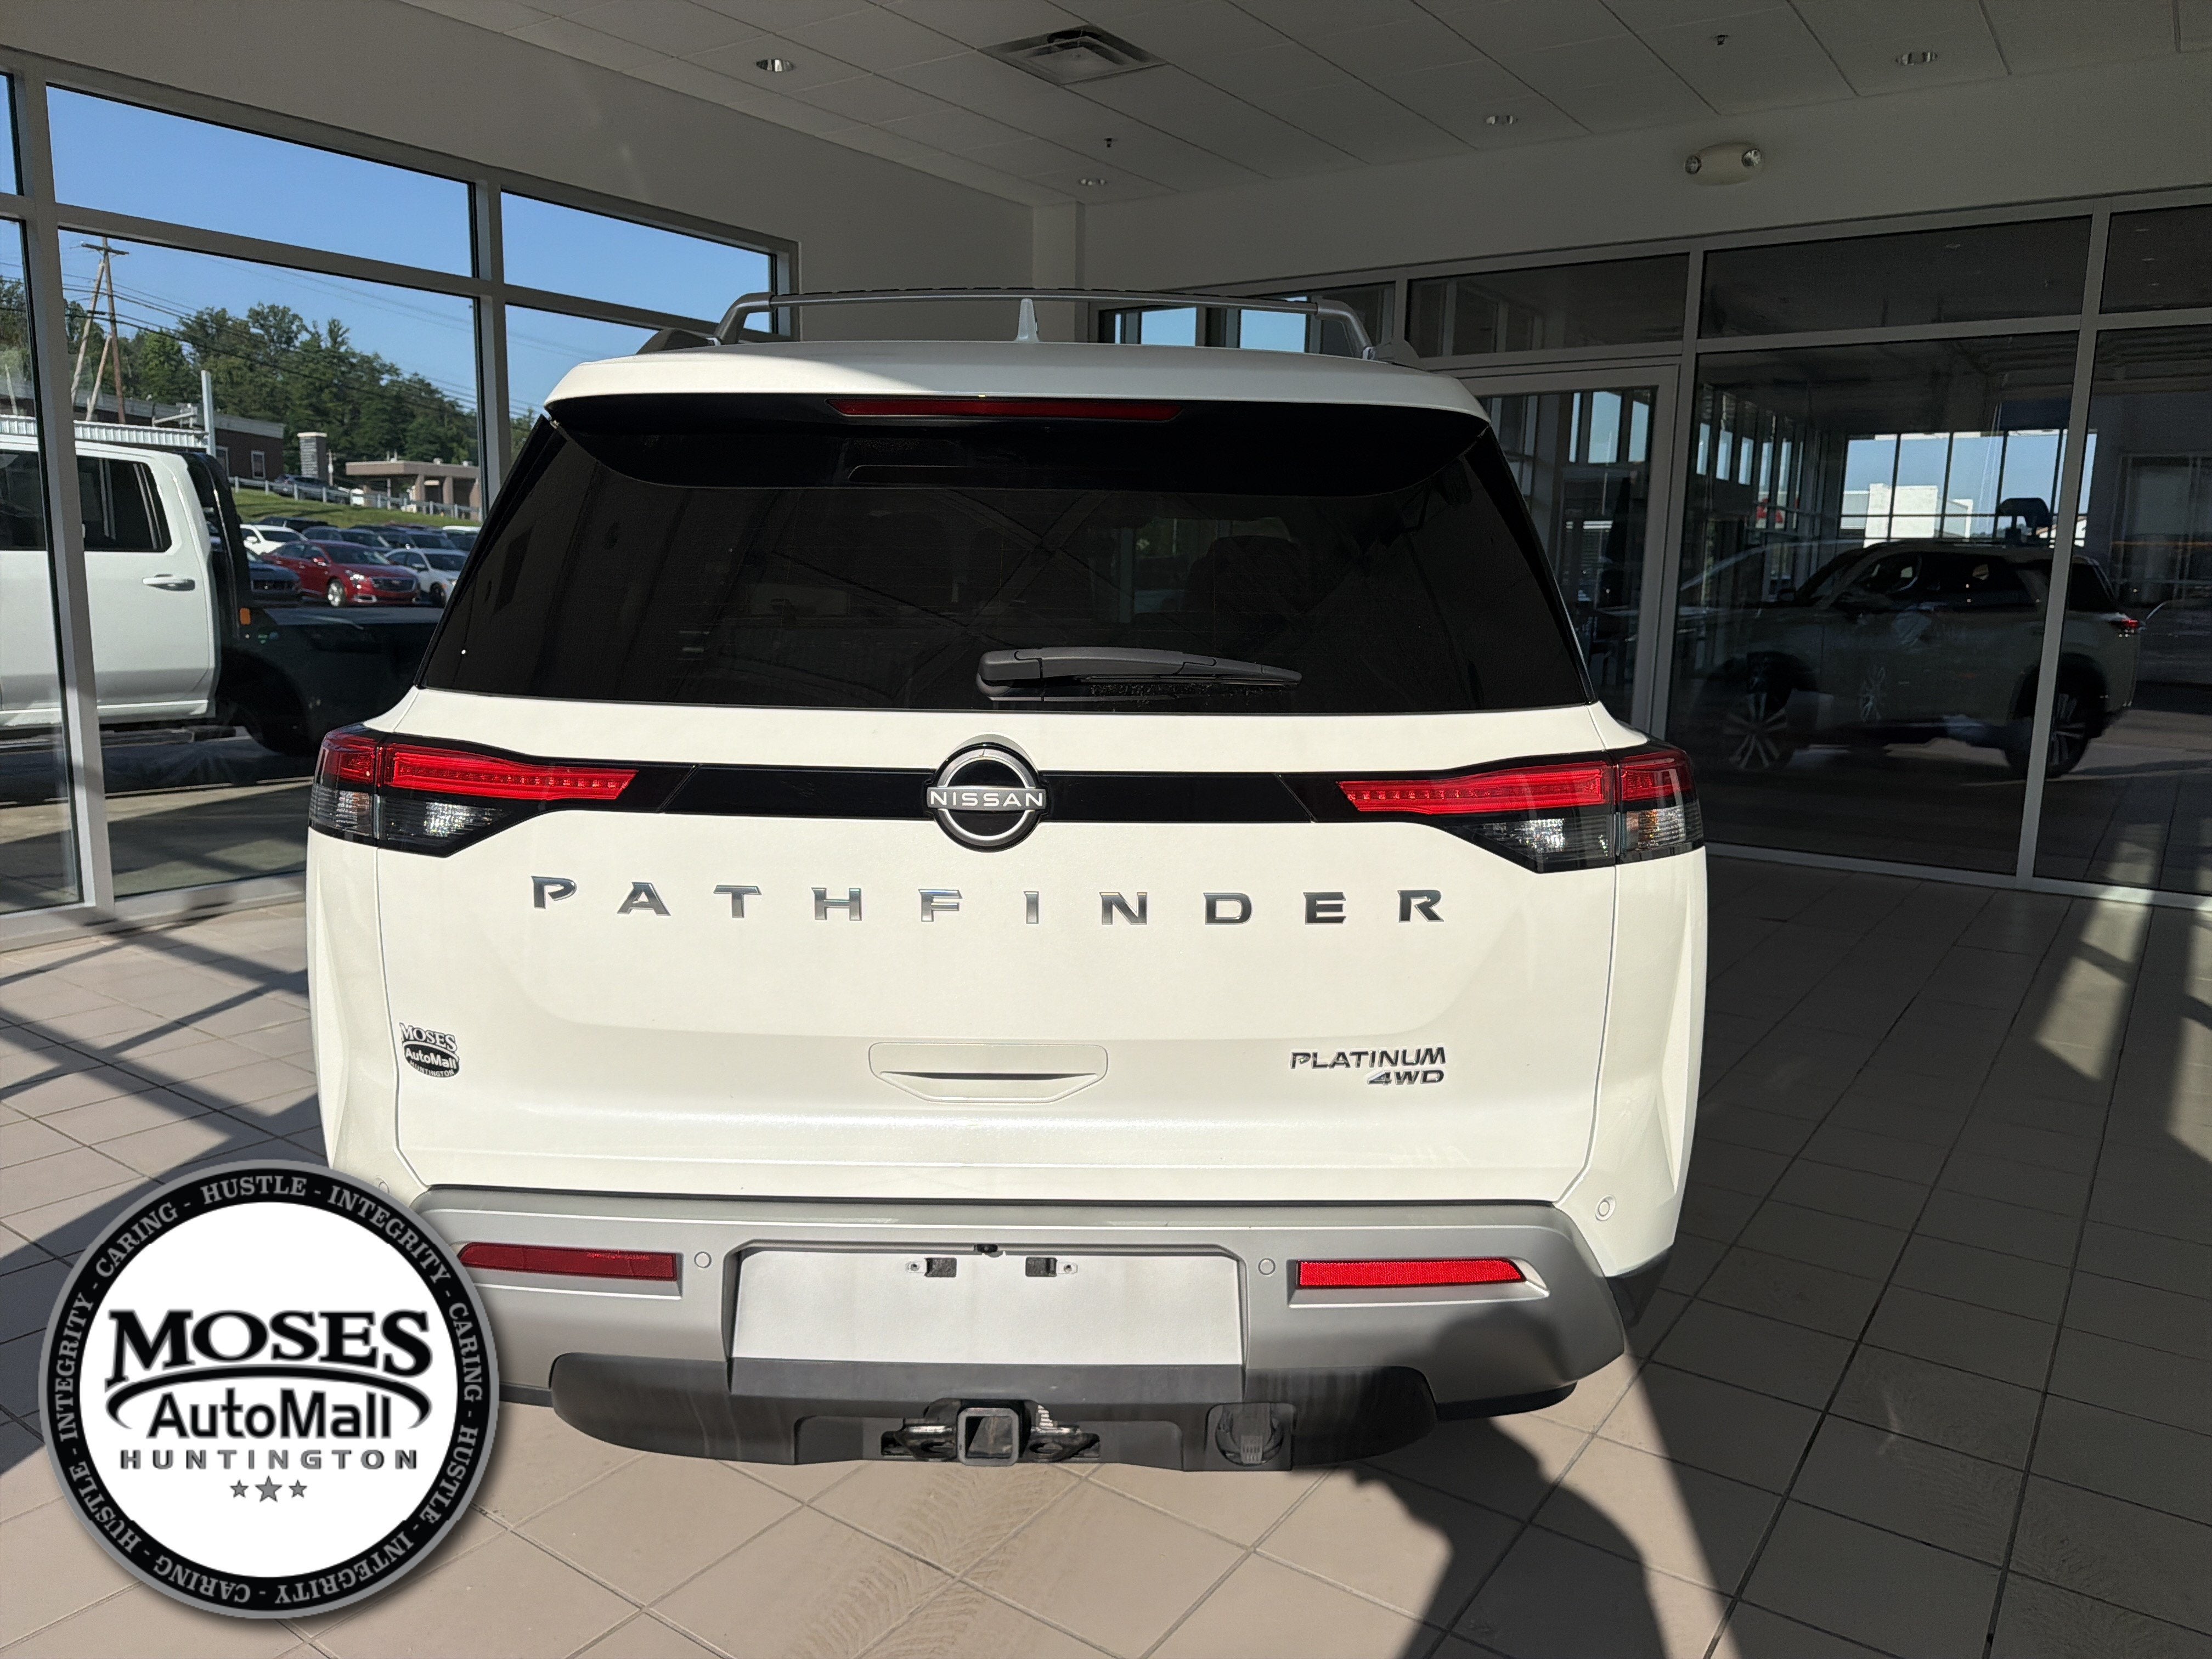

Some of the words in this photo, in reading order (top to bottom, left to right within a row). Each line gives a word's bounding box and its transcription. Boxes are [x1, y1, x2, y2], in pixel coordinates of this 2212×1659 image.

[930, 791, 1042, 807] NISSAN
[531, 876, 1444, 926] PATHFINDER
[399, 1022, 458, 1052] MOSES
[405, 1047, 456, 1069] AutoMall
[409, 1060, 455, 1077] HUNTINGTON
[1290, 1046, 1446, 1069] PLATINUM
[1367, 1070, 1444, 1086] 4WD
